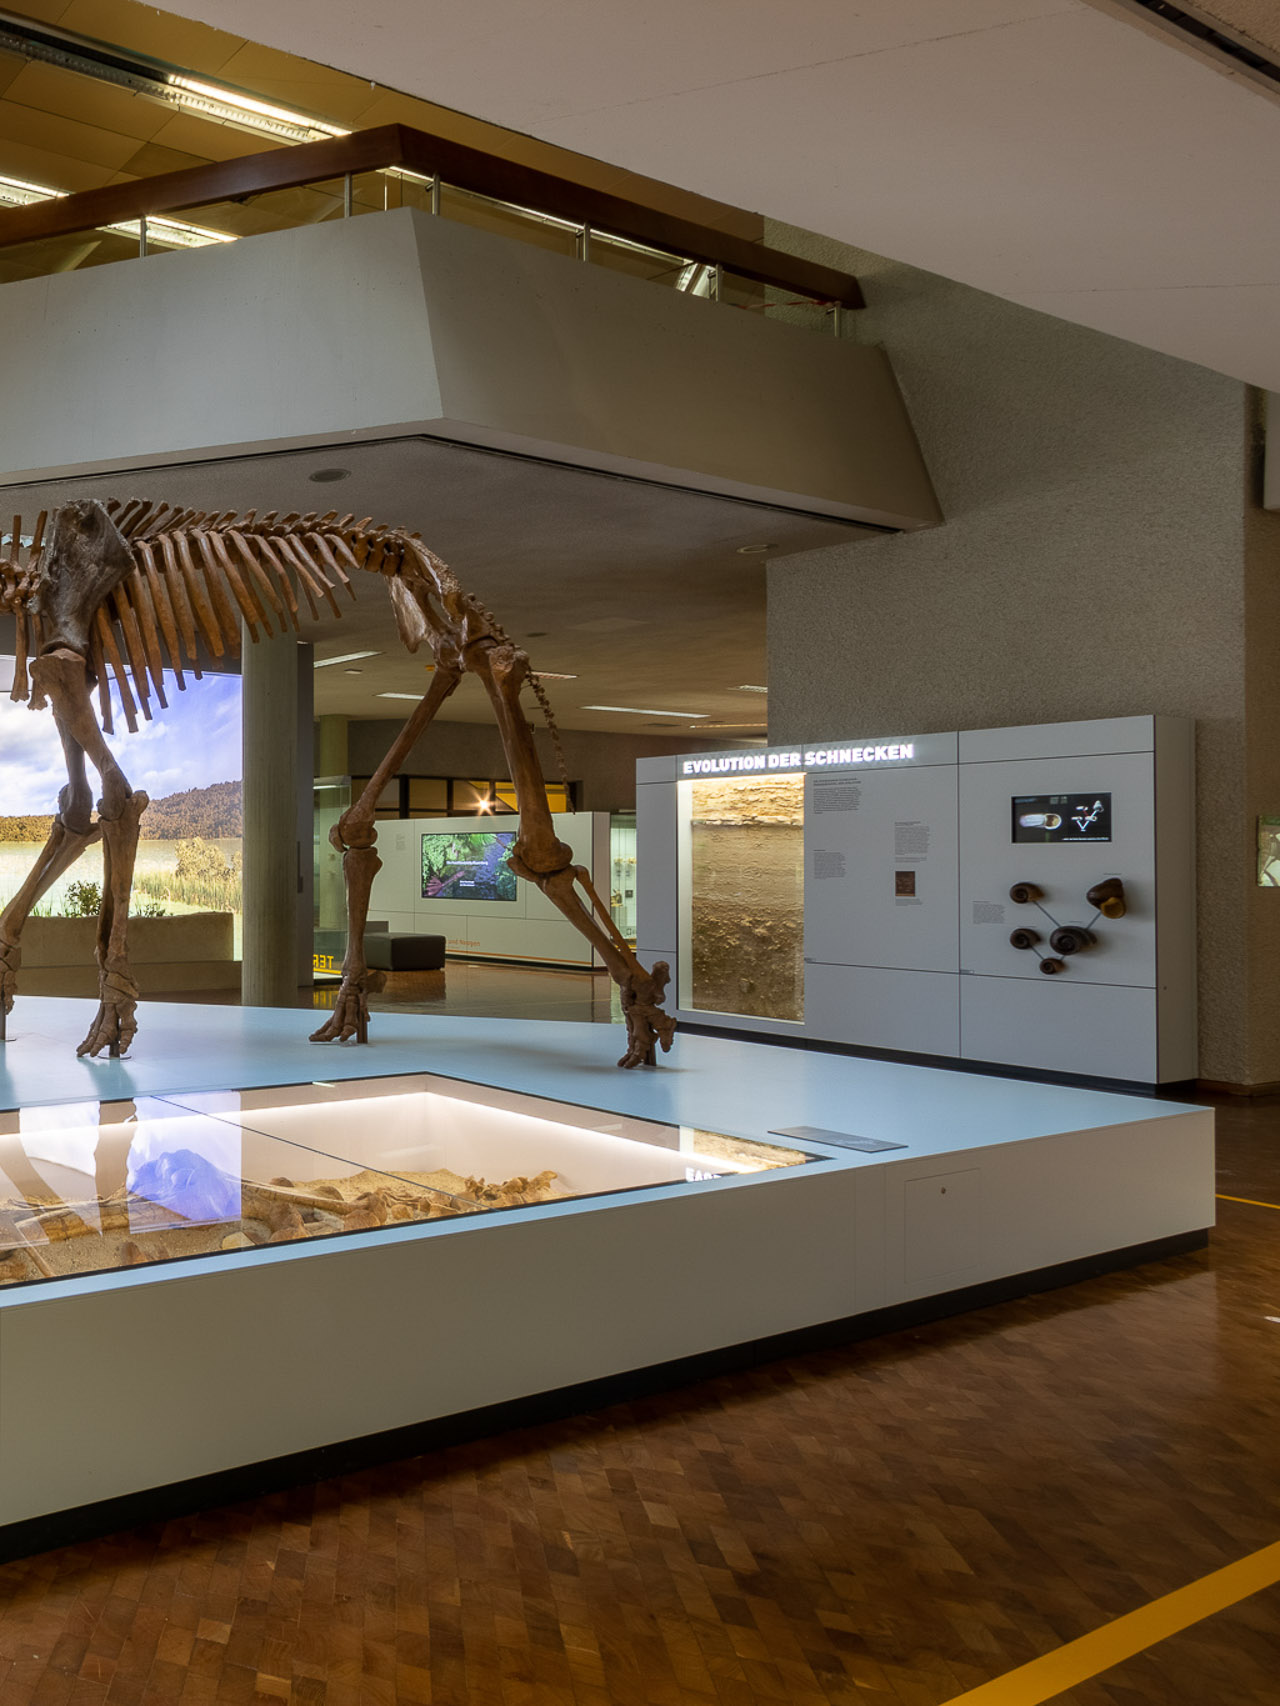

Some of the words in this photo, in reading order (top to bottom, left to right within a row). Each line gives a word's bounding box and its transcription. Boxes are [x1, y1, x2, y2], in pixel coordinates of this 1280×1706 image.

[682, 757, 766, 775] EVOLUTION
[768, 752, 802, 769] DER
[804, 744, 915, 766] SCHNECKEN
